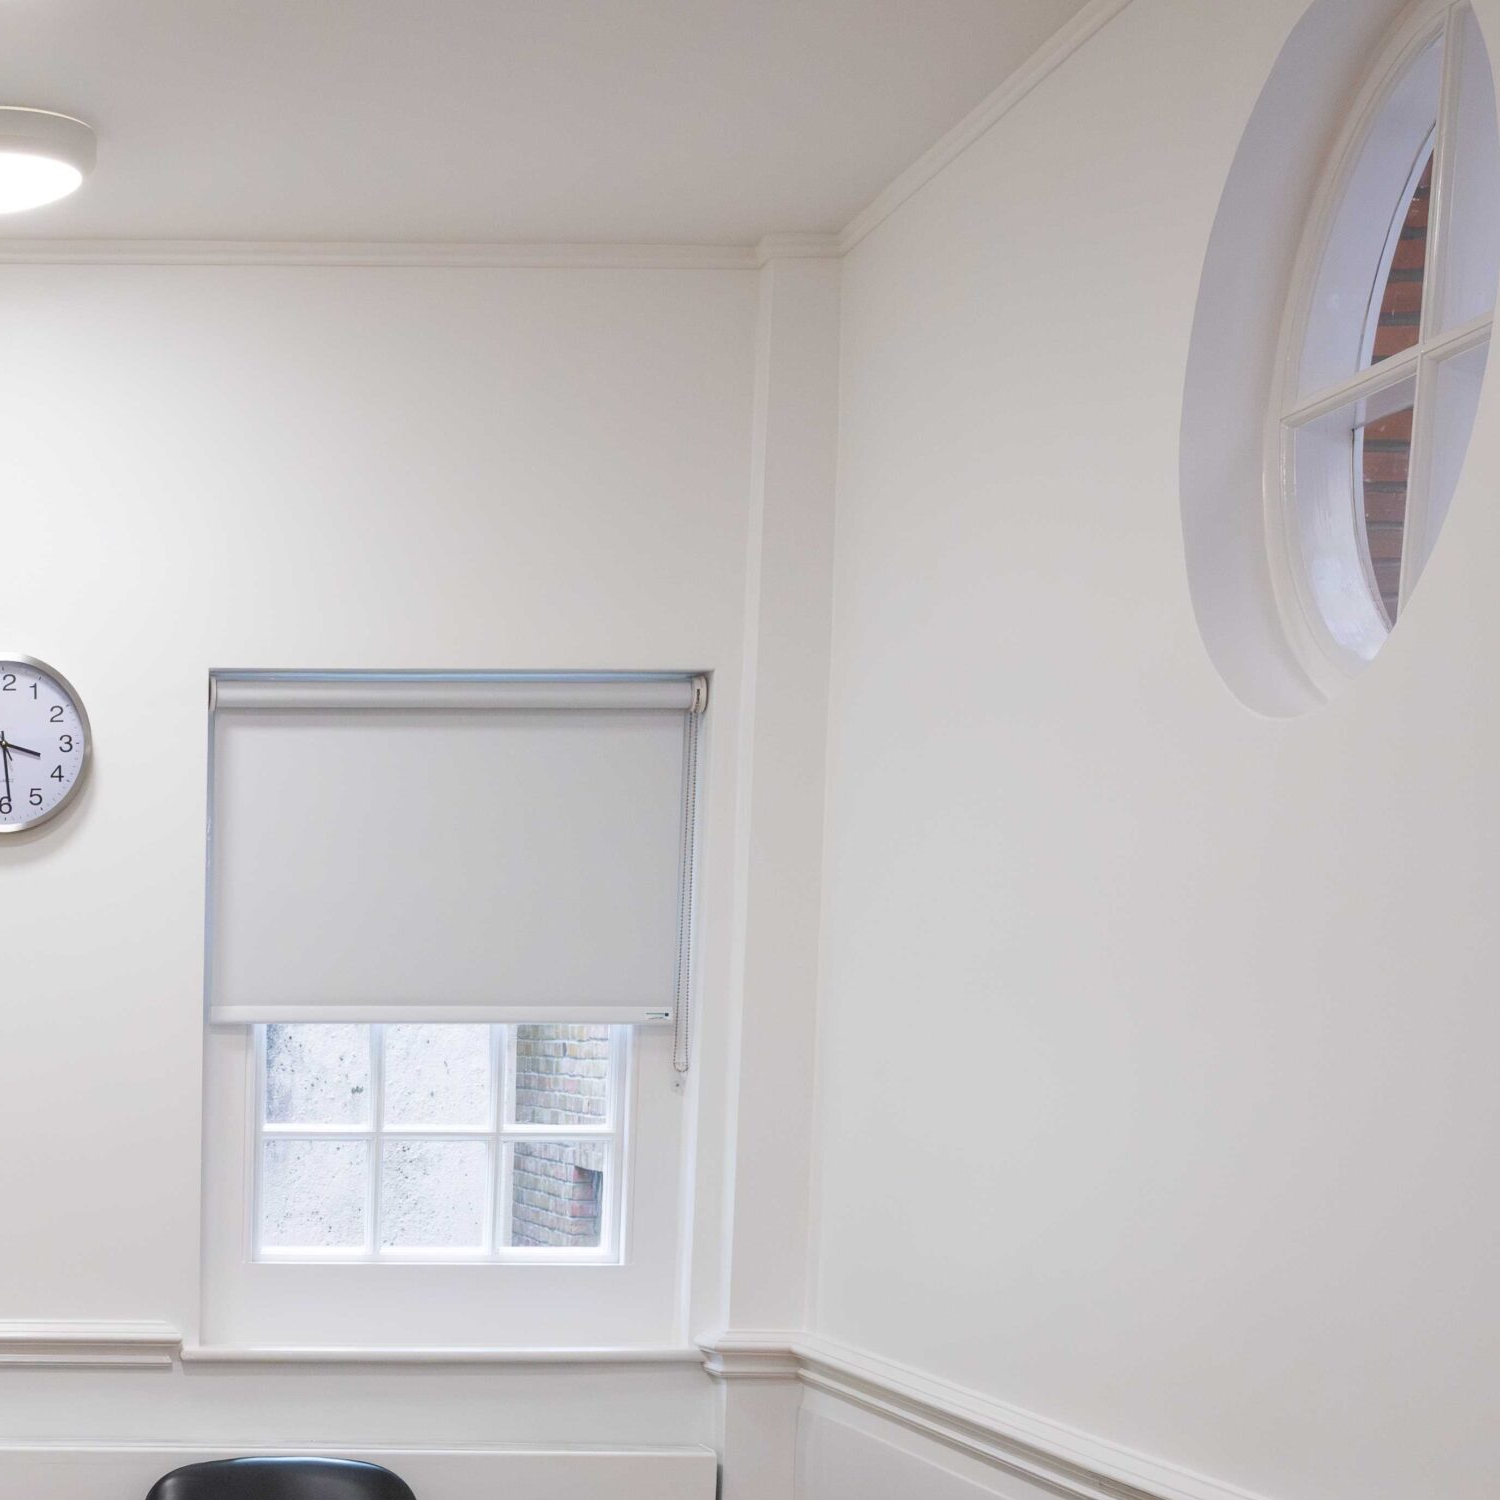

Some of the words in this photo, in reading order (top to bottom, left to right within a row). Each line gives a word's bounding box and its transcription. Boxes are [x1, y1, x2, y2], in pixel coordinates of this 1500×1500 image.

[30, 683, 38, 700] 1
[50, 706, 64, 722] 2
[59, 734, 73, 752] 3
[50, 765, 64, 782] 4
[29, 788, 42, 805] 5
